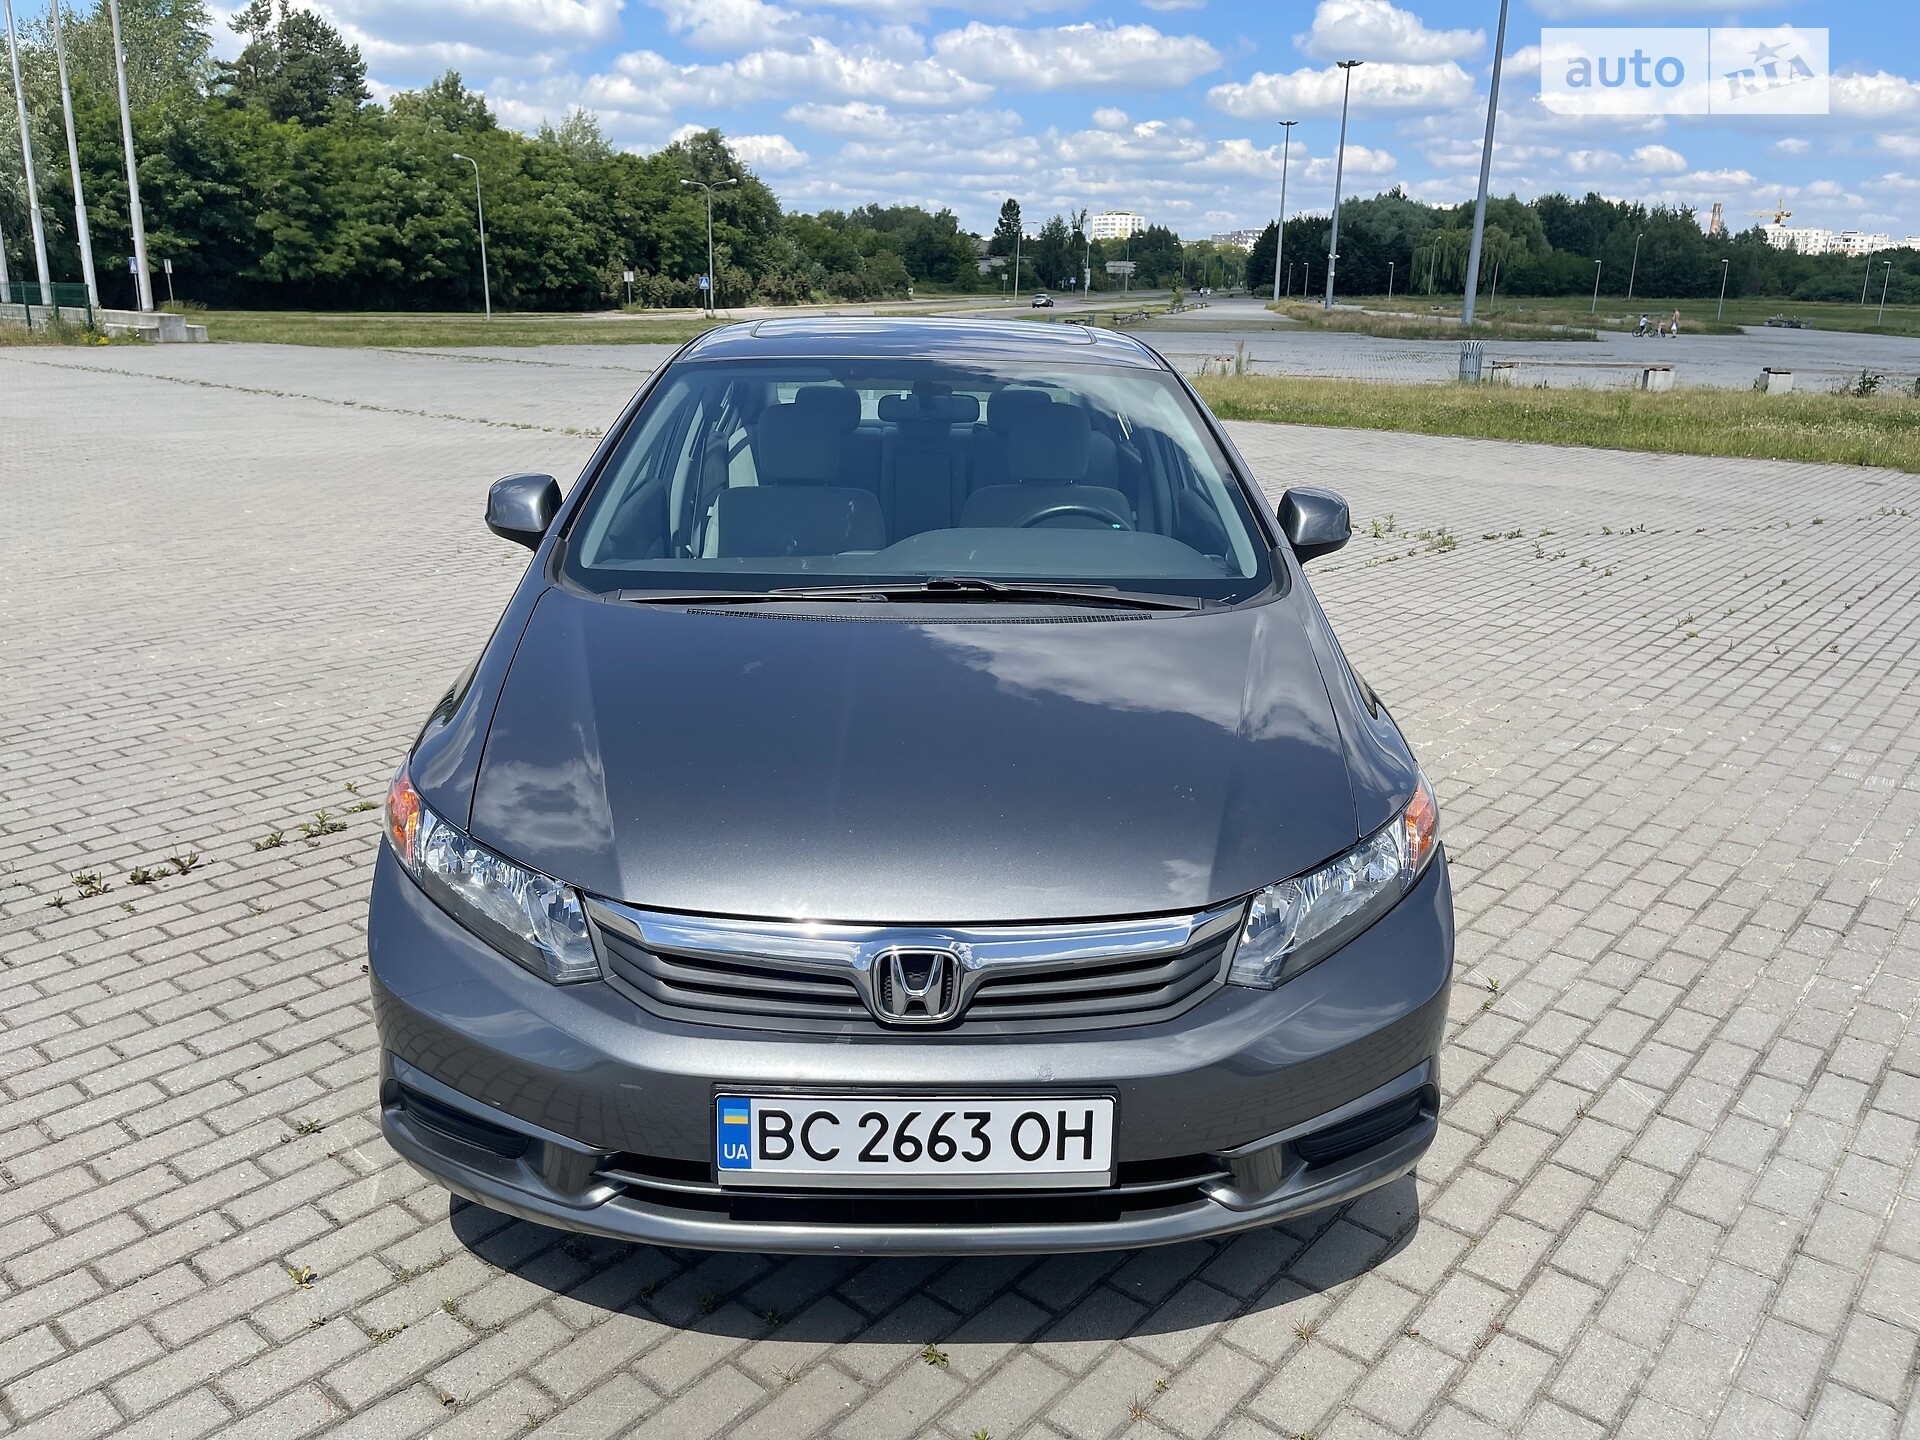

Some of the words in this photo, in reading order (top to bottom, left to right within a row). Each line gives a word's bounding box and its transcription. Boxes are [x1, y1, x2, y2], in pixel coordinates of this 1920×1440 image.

[723, 1143, 749, 1160] UA
[758, 1109, 840, 1162] BC
[857, 1111, 992, 1163] 2663
[1010, 1110, 1094, 1162] OH
